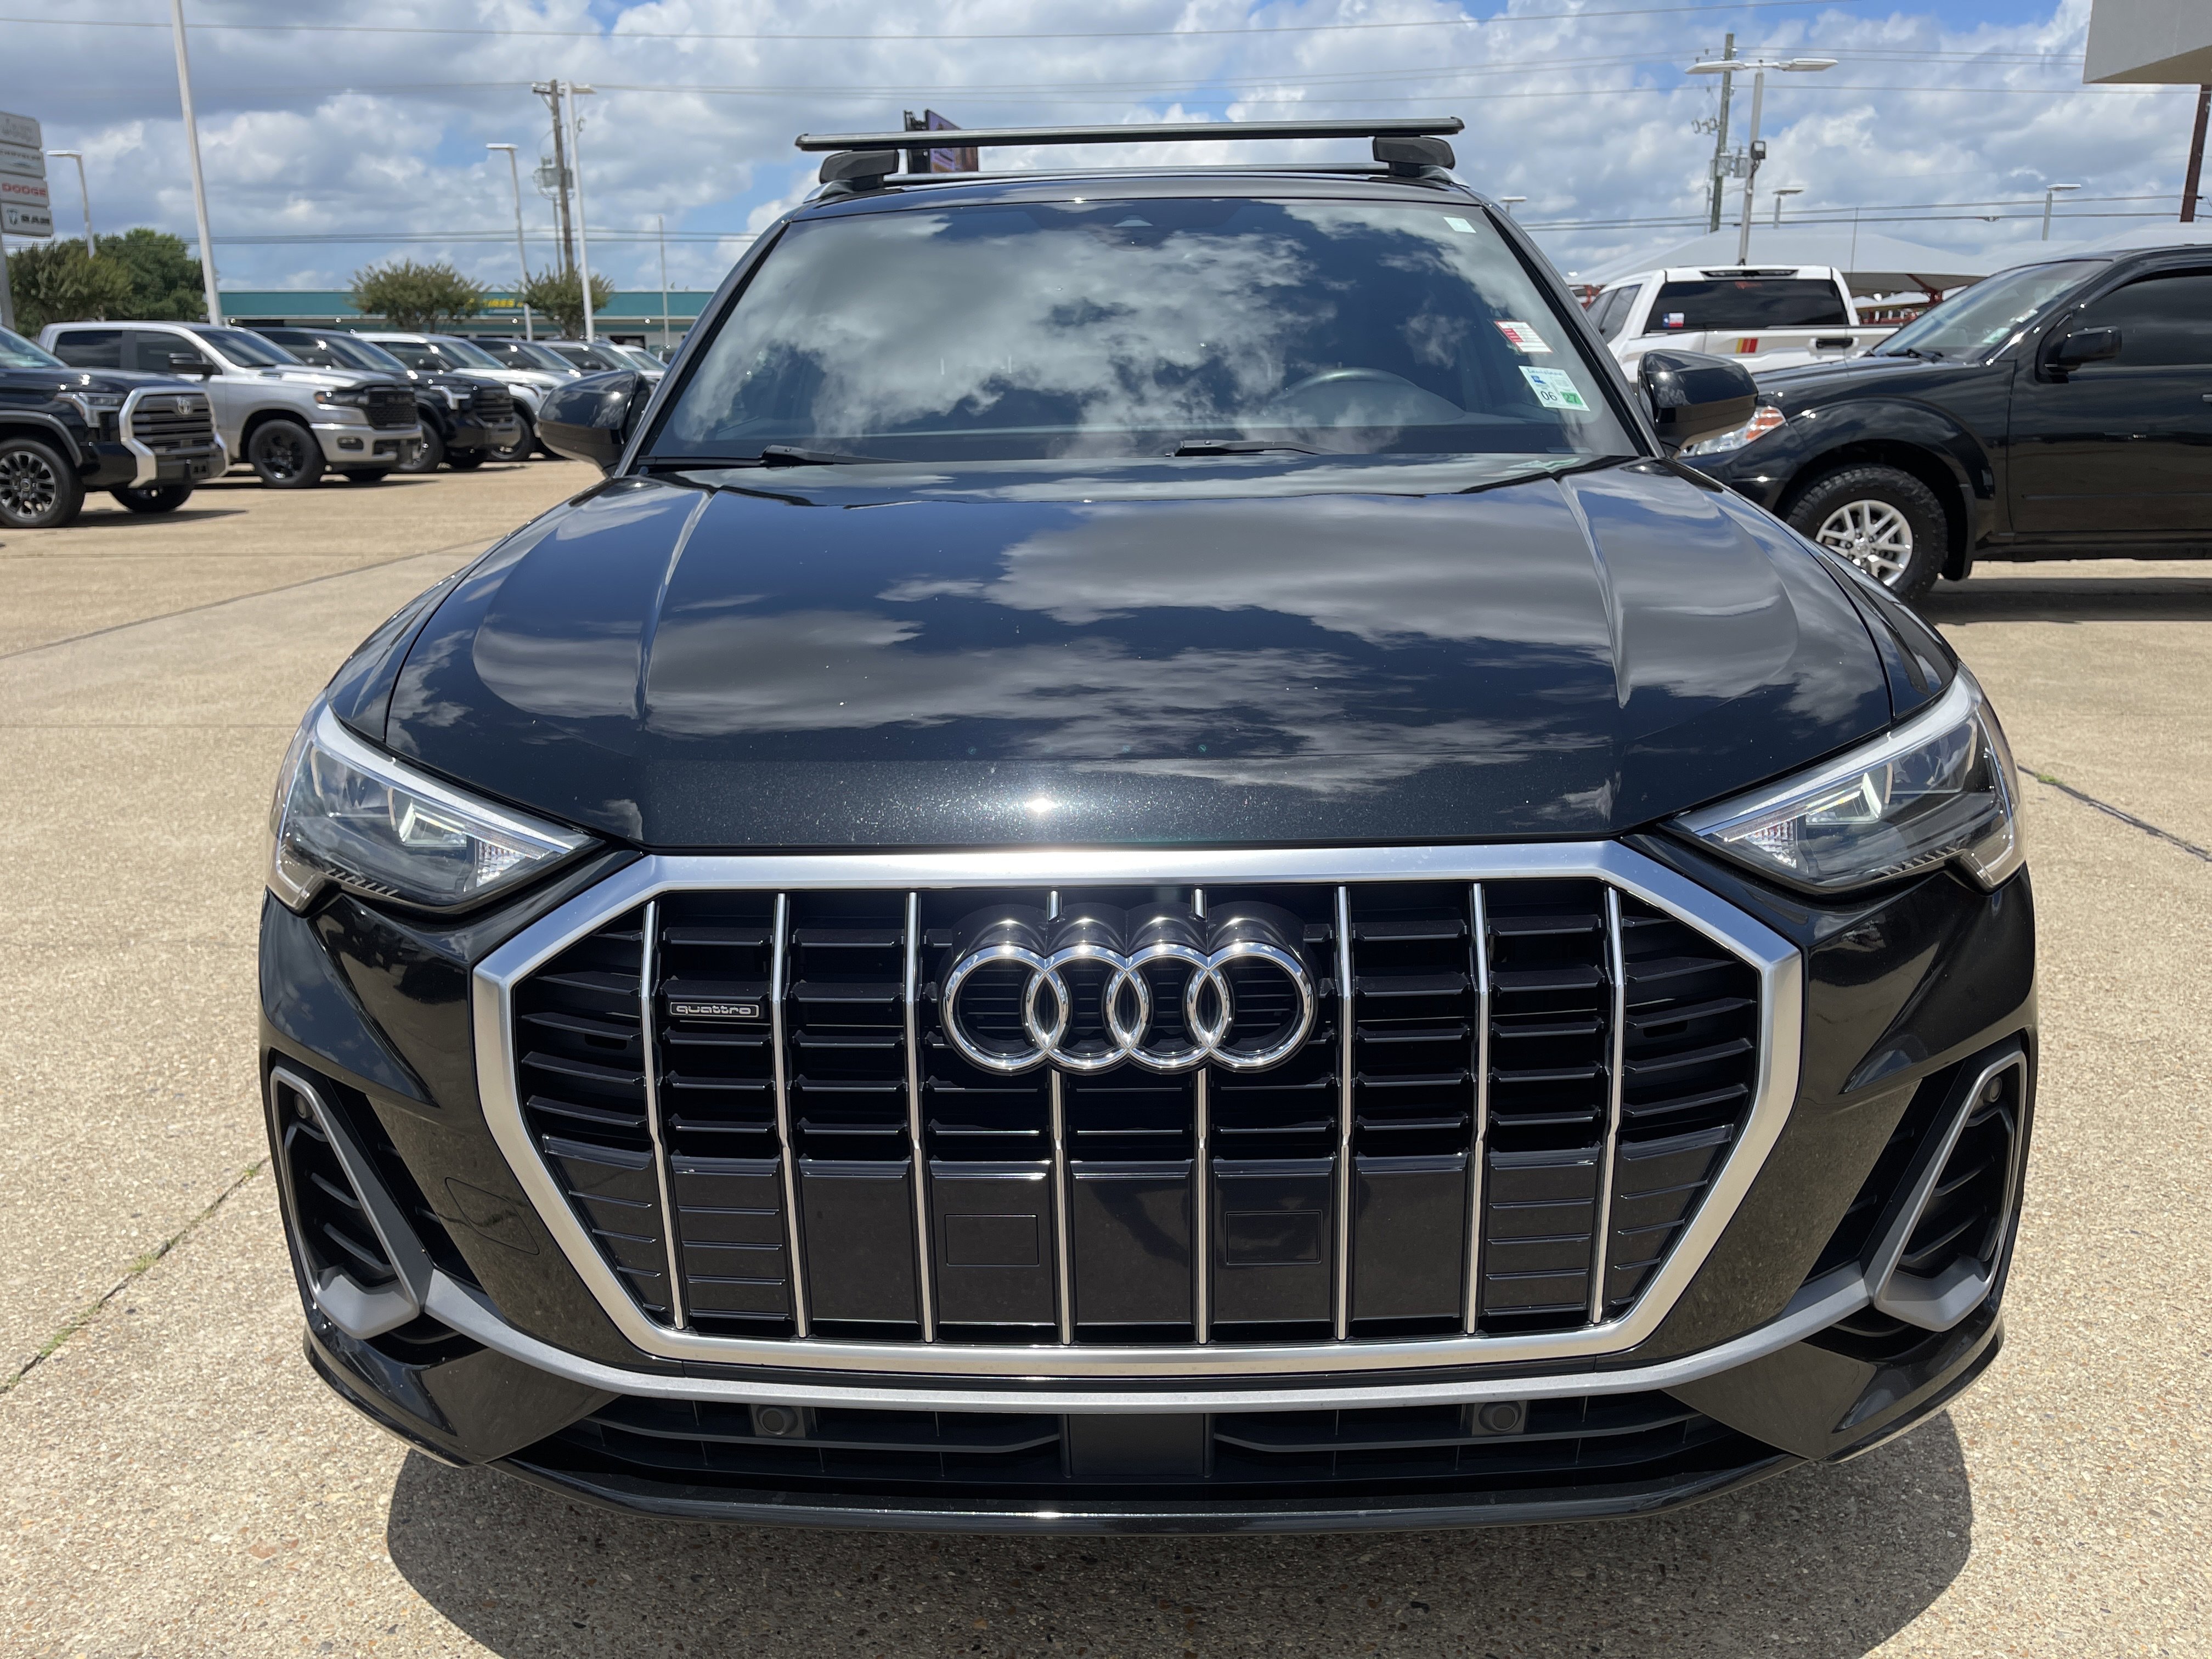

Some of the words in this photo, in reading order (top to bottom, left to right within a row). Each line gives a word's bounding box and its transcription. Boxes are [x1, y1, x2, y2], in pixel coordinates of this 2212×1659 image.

[2, 183, 46, 197] DODGE
[21, 214, 50, 224] RAM
[1541, 391, 1557, 401] 06
[1562, 393, 1578, 403] 27
[676, 1005, 751, 1014] quattro
